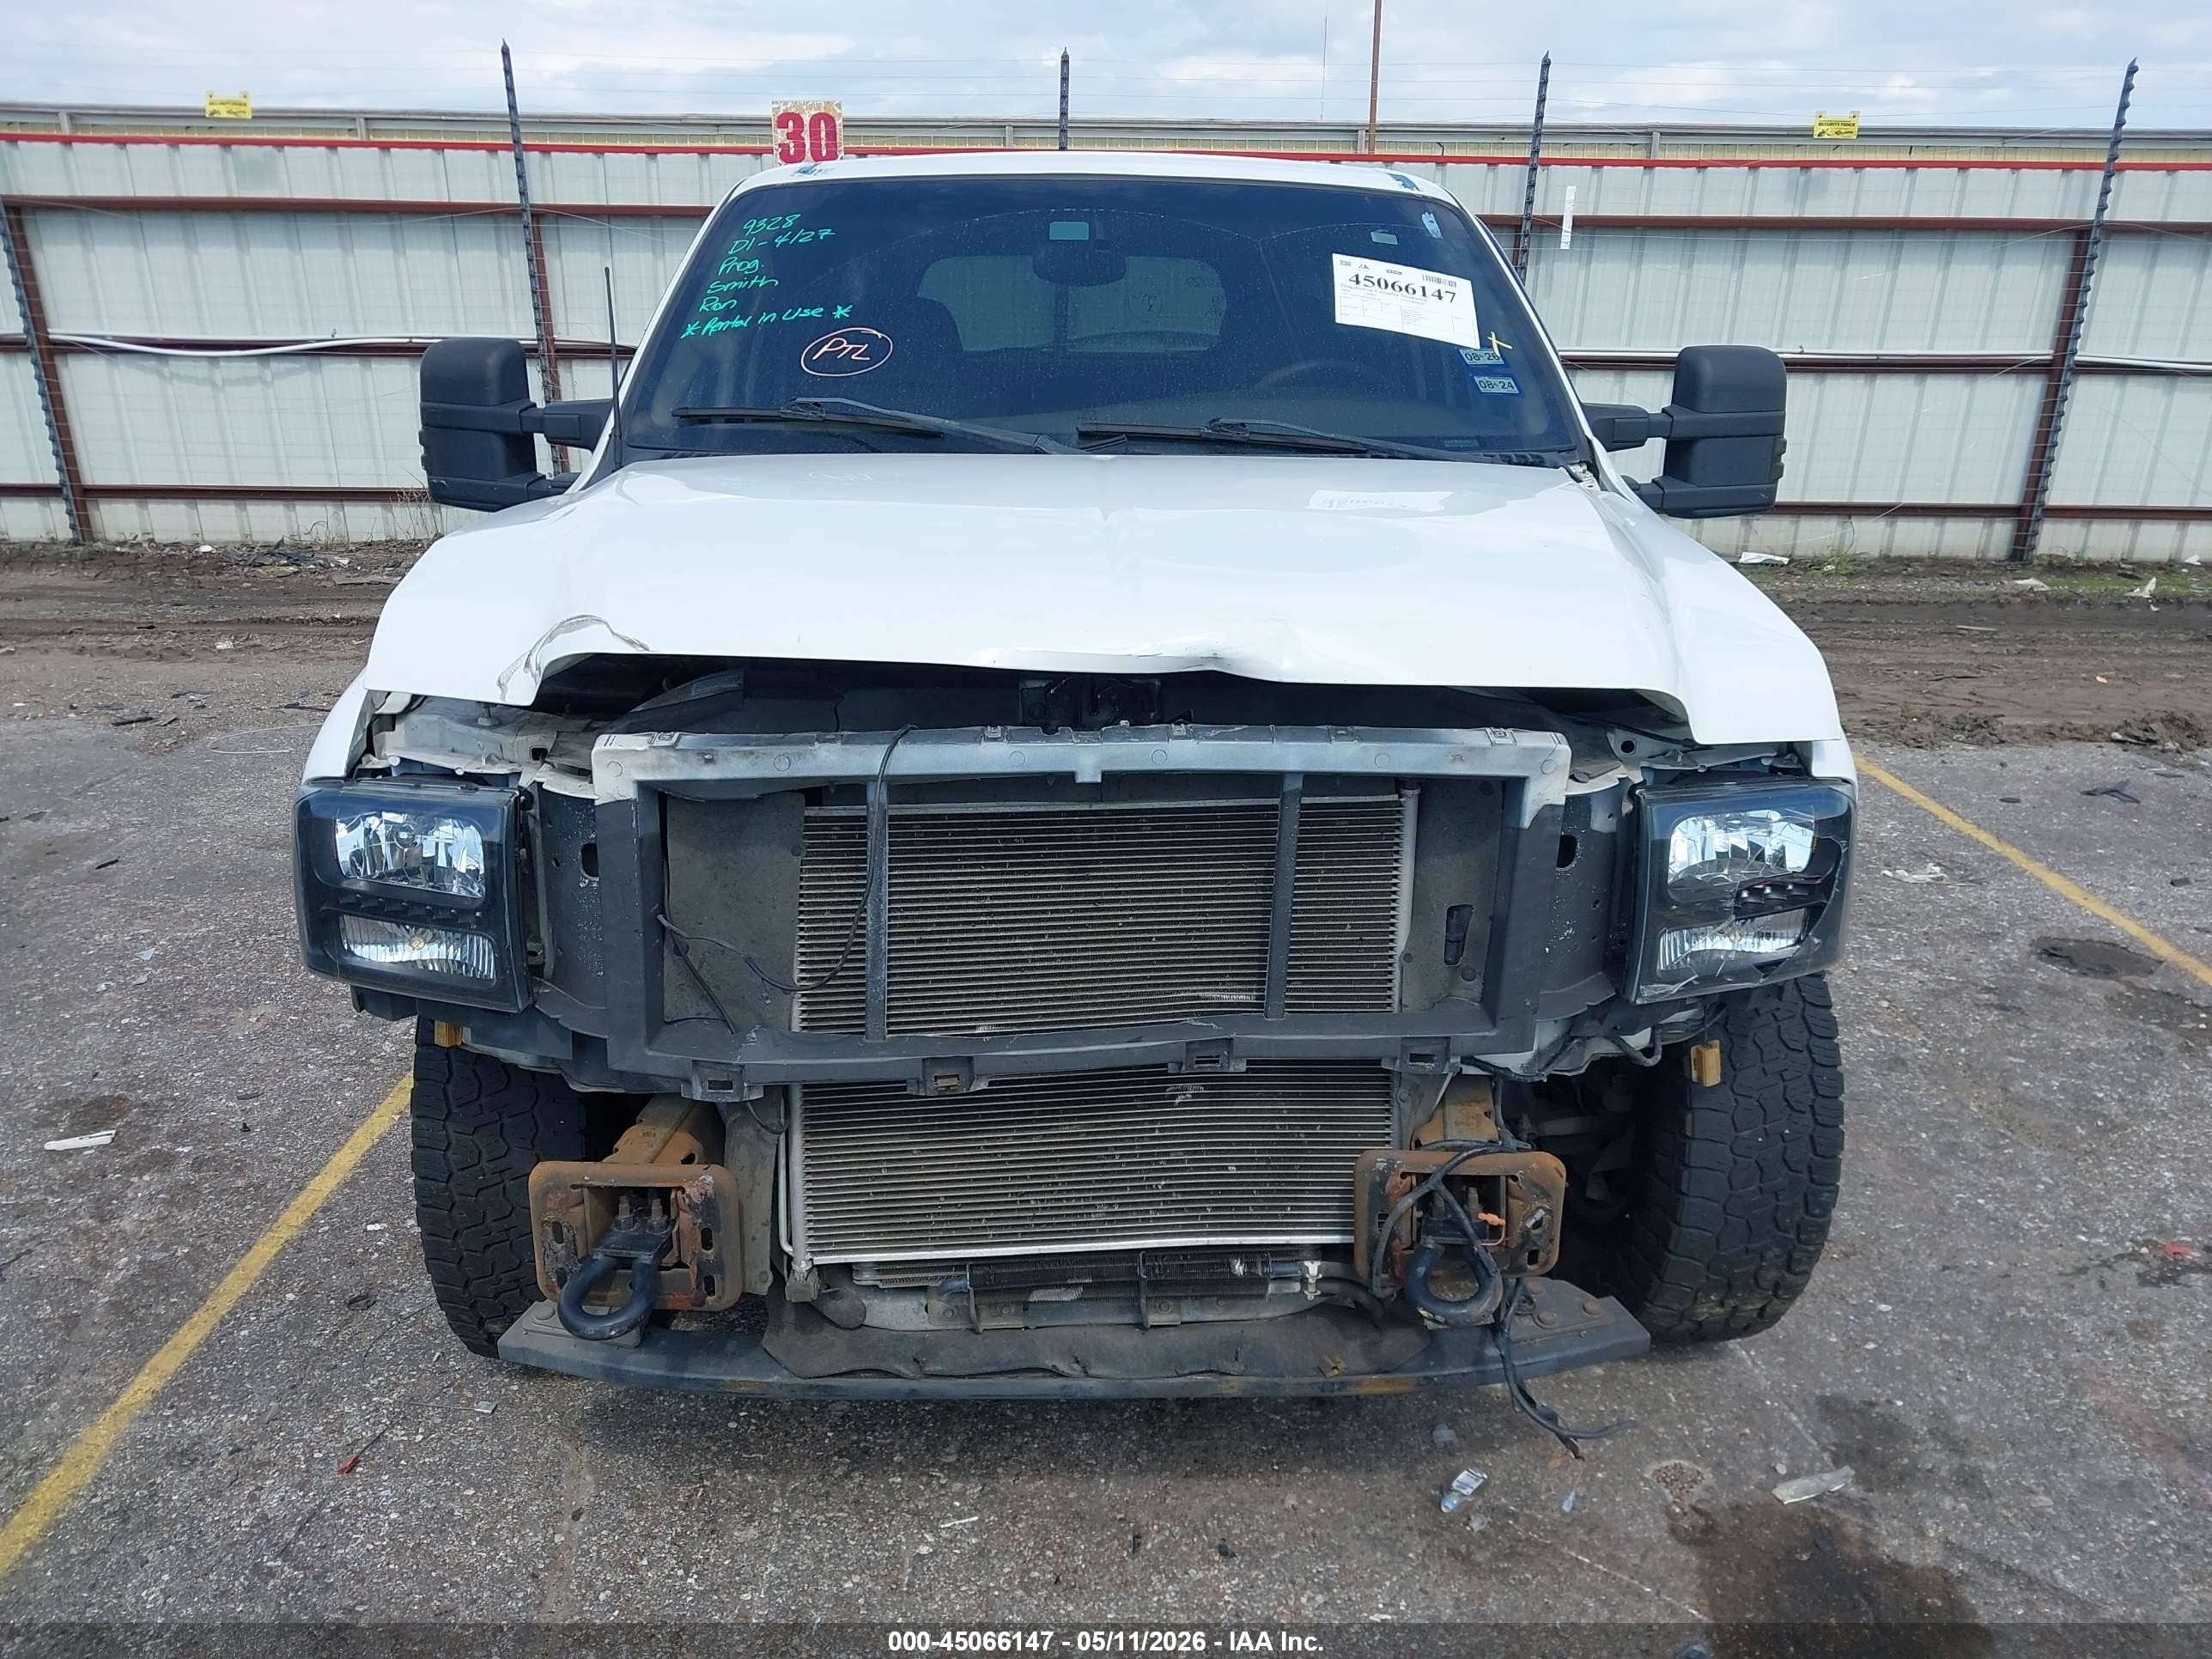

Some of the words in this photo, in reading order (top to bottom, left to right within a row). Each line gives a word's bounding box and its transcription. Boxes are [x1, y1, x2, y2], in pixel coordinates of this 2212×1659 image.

[777, 112, 838, 164] 30
[743, 214, 801, 236] 9328
[707, 275, 779, 294] Smith
[1348, 273, 1457, 303] 45066147
[758, 312, 777, 325] in
